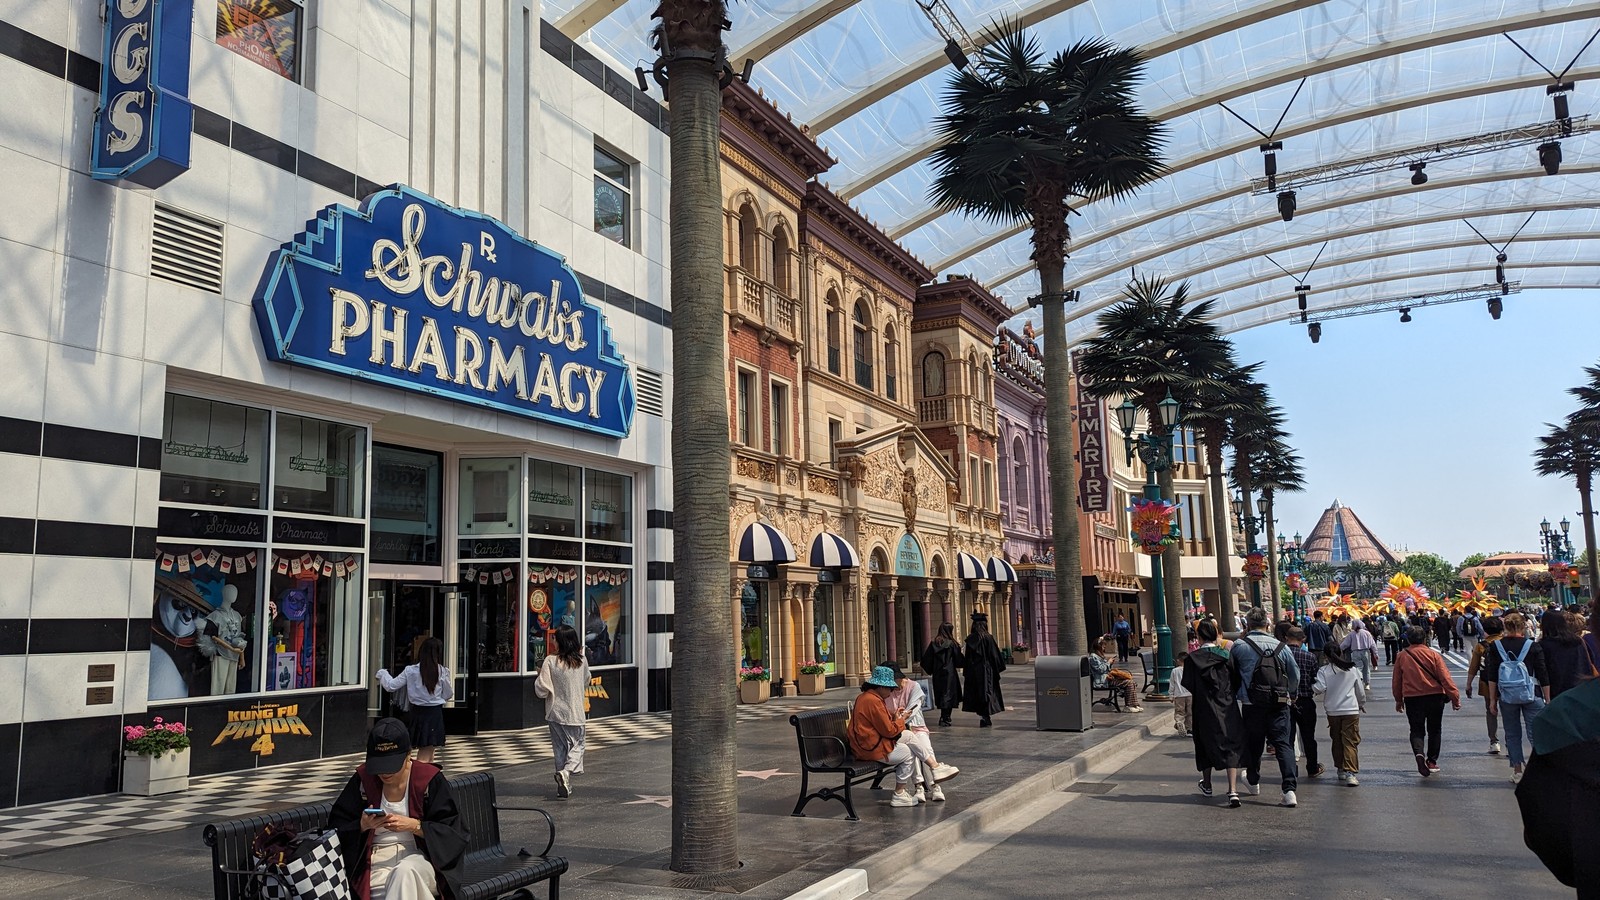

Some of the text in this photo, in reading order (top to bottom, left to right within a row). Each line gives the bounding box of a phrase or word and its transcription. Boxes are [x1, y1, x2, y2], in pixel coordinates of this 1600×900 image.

[240, 40, 270, 62] PHONE
[365, 203, 588, 352] Schwab's
[328, 286, 607, 420] PHARMACY
[204, 514, 328, 544] Schwab's Pharmacy
[474, 541, 505, 557] Candy
[227, 703, 299, 722] KUNG FU
[210, 715, 313, 747] PANDA
[250, 733, 275, 756] 4
